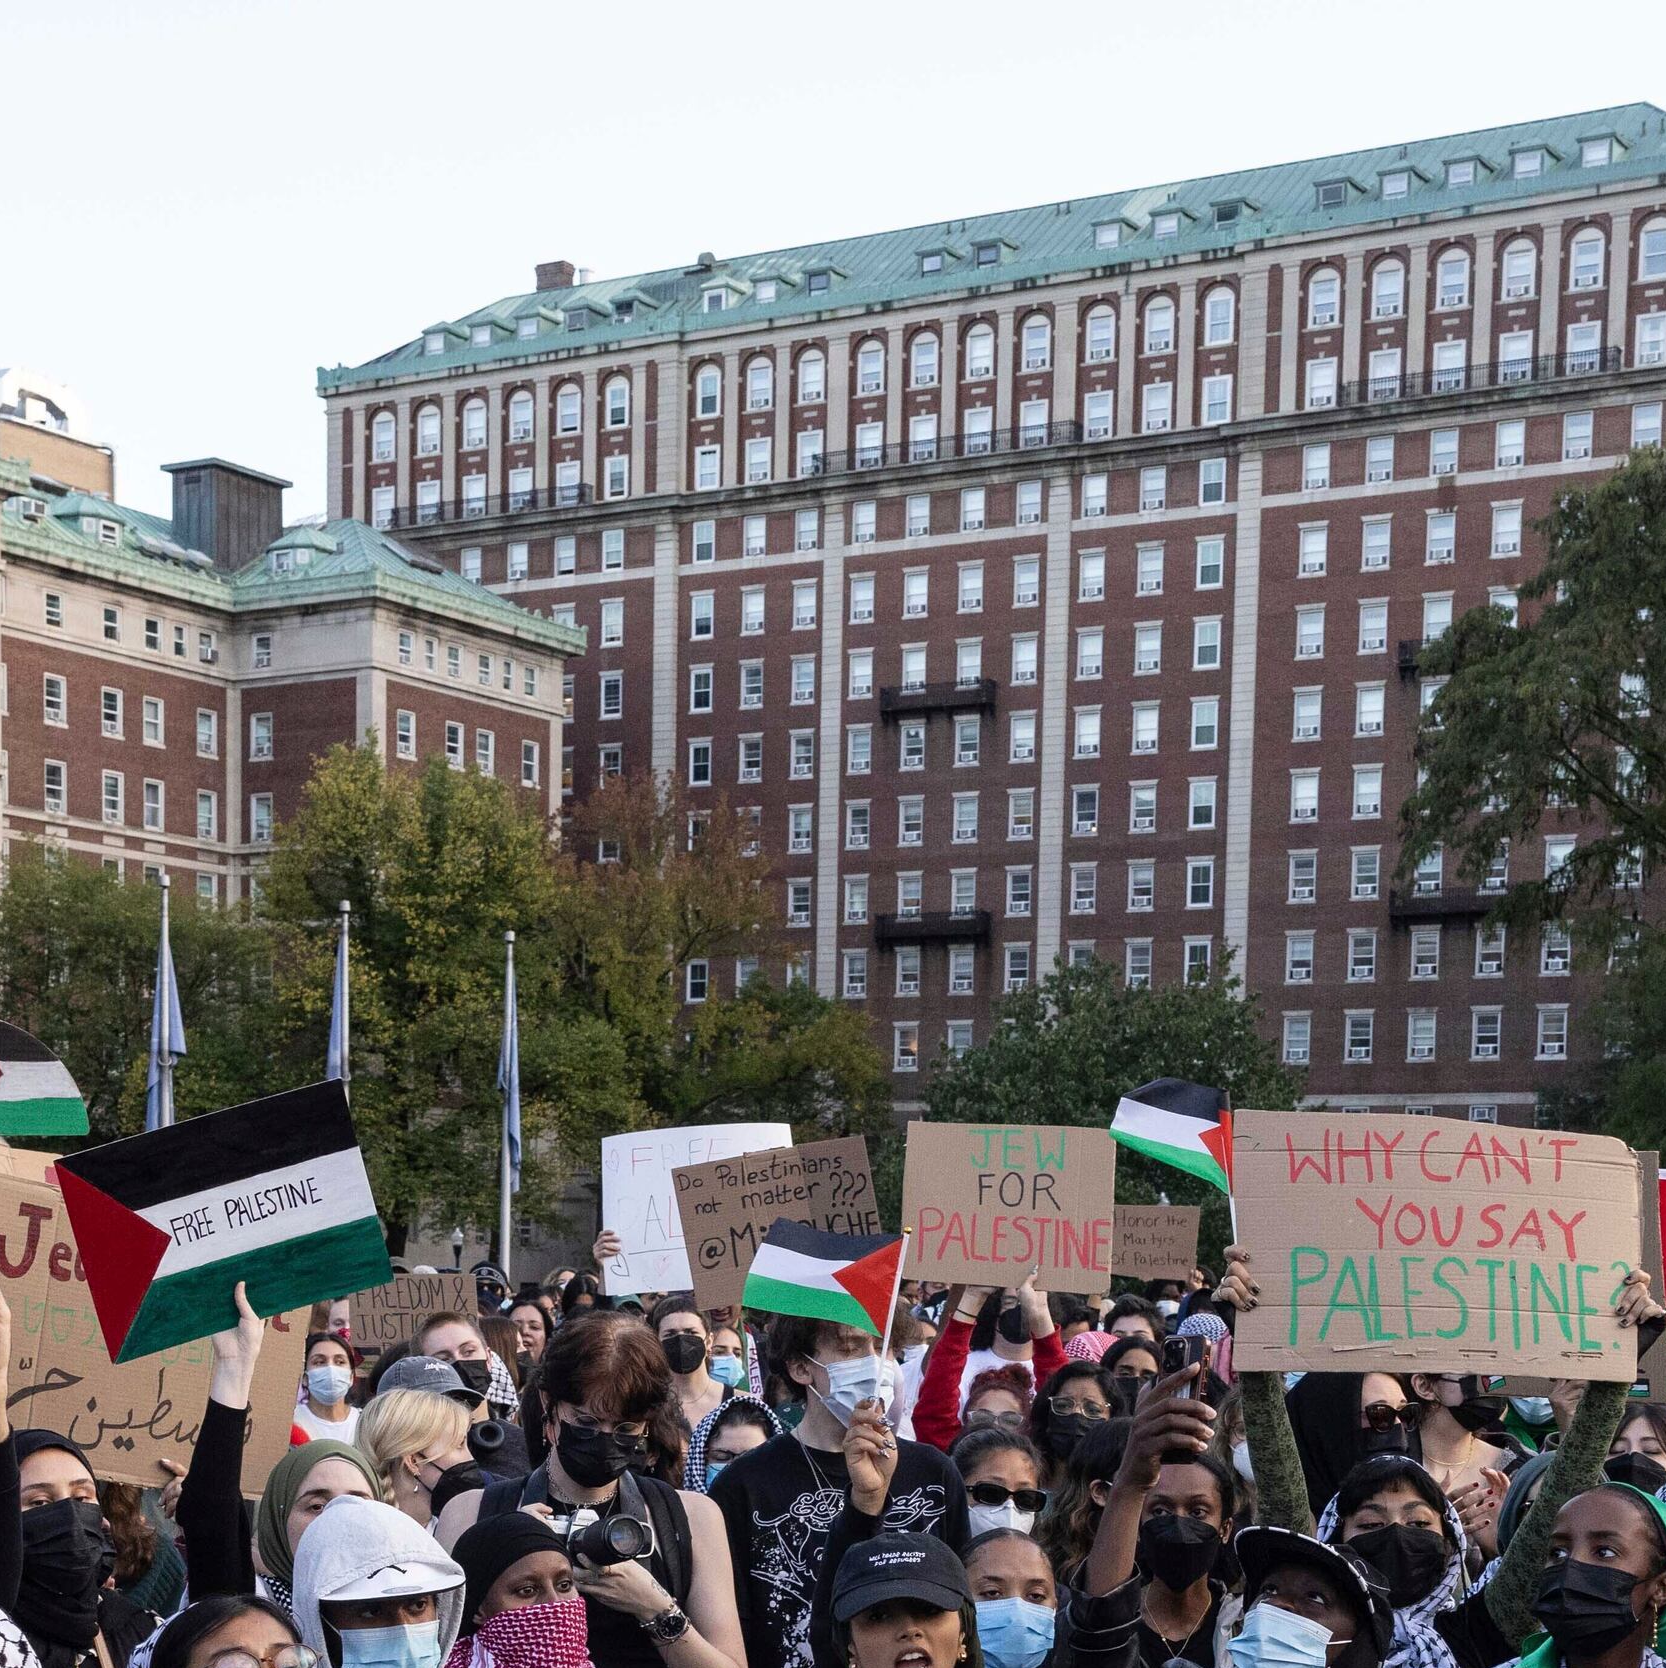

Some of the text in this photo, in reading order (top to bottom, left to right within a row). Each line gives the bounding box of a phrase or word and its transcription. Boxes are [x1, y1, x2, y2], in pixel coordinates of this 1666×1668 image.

[675, 1153, 843, 1192] Do Palestinians
[970, 1129, 1066, 1172] JEW
[1285, 1128, 1578, 1184] WHY CAN'T
[170, 1177, 322, 1246] FREE PALESTINE
[694, 1170, 867, 1215] not matter ???
[977, 1172, 1061, 1211] FOR
[616, 1193, 685, 1246] PAL
[916, 1206, 1112, 1272] PALESTINE
[1112, 1209, 1188, 1228] Honor the
[1122, 1232, 1176, 1249] Martyrs
[1355, 1194, 1587, 1262] YOU SAY
[1133, 1251, 1189, 1267] Palestine
[354, 1276, 469, 1312] FREEDOM &
[1289, 1245, 1629, 1352] PALESTINE?
[356, 1312, 425, 1342] JUSTIC
[749, 1347, 762, 1395] PALES
